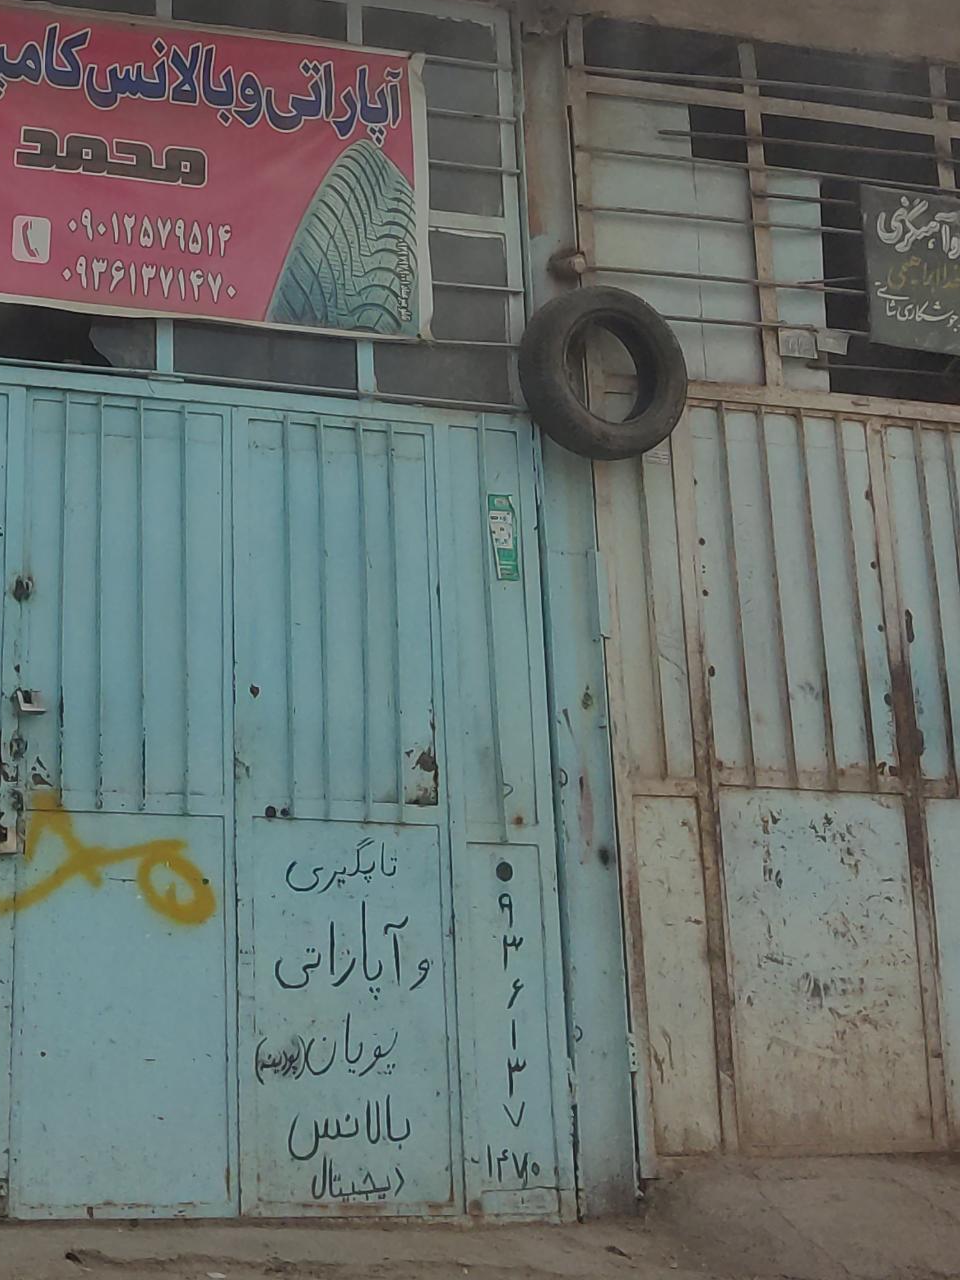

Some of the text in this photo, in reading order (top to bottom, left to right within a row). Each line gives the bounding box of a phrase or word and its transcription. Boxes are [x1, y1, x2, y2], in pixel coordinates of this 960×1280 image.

[84, 37, 237, 126] بالانس
[264, 59, 402, 147] آپاراتی
[14, 126, 208, 188] محمد
[68, 208, 232, 257] ۰۹۰۱۲۵۷۹۵۱۴
[62, 255, 237, 303] ۰۹۳۶۱۳۷۱۴۷۰
[289, 1094, 411, 1160] بالانس
[312, 1154, 405, 1201] دیجیتال
